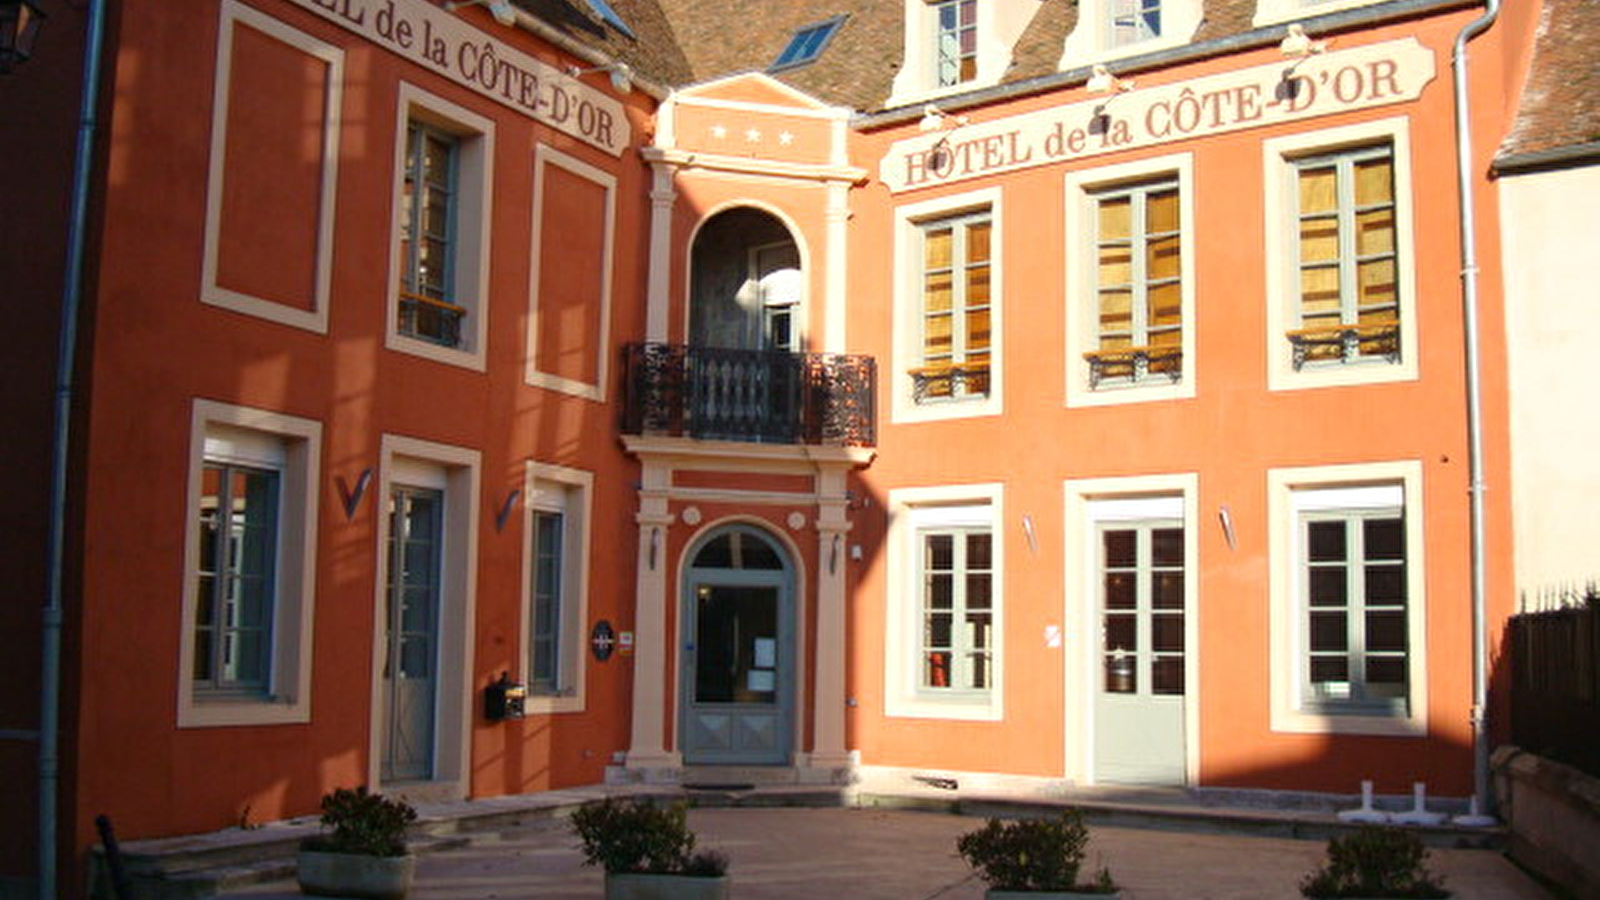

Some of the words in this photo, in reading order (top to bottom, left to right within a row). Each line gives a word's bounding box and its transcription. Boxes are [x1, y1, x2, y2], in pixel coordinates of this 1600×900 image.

[376, 0, 412, 49] de
[422, 19, 449, 67] la
[458, 43, 616, 149] CÔTE-D'OR
[904, 130, 1032, 186] HÔTEL
[1044, 121, 1086, 158] de
[1099, 113, 1133, 148] la
[1144, 59, 1403, 138] CÔTE-D'OR
